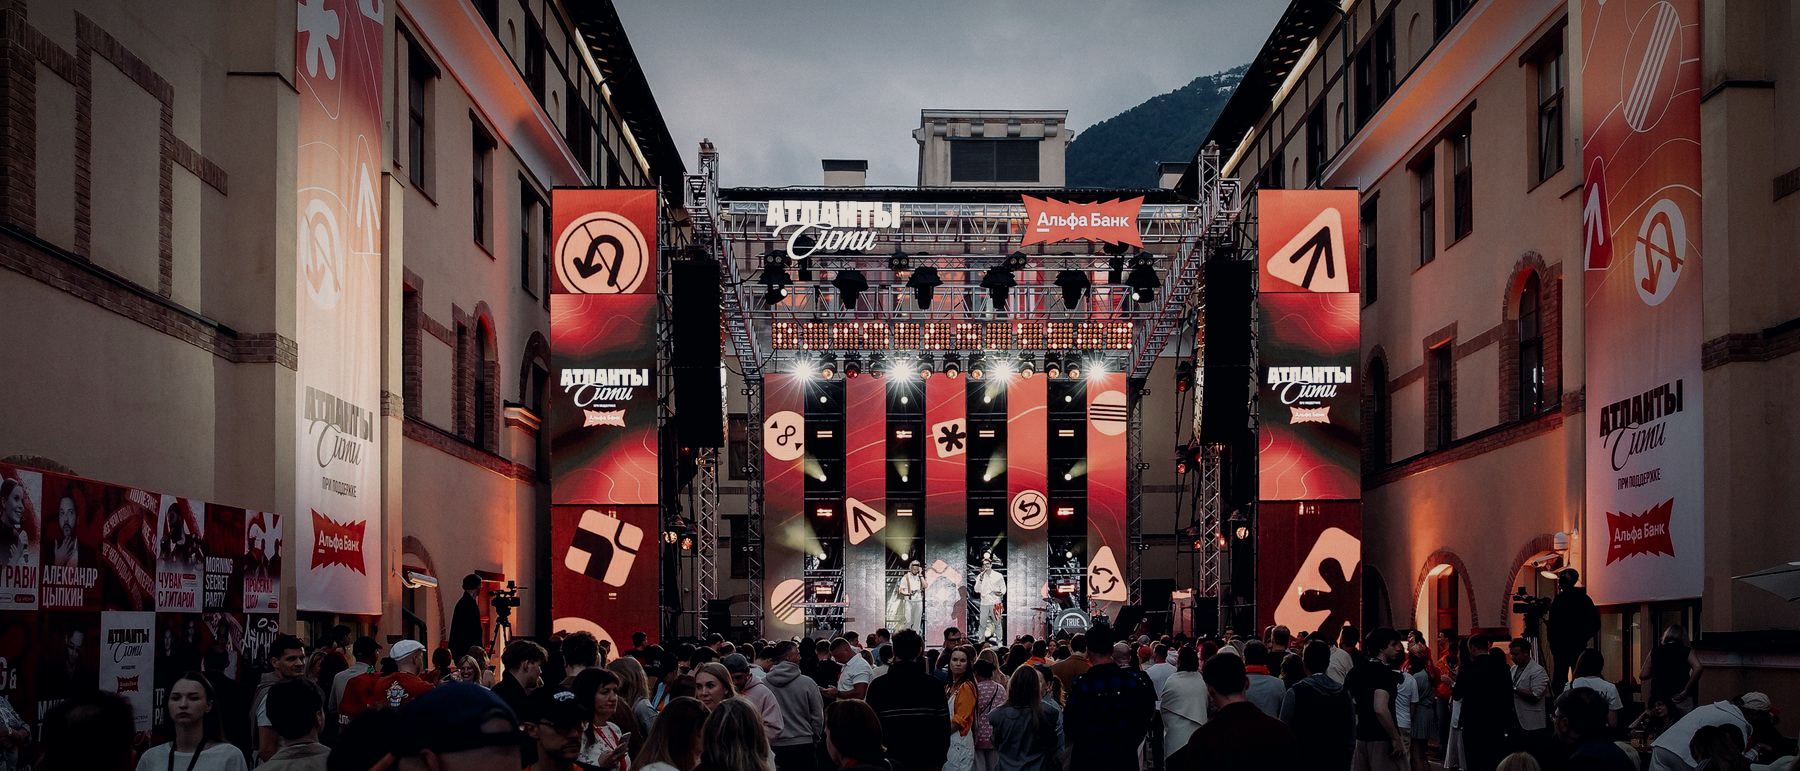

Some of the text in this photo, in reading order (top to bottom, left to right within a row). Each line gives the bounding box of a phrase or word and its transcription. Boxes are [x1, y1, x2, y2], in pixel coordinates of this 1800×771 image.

[766, 200, 901, 228] АТЛАНТЫ
[1037, 211, 1130, 231] Альфа Банк
[772, 222, 877, 260] Сити
[560, 368, 649, 386] АТЛАНТЫ
[1267, 366, 1352, 384] АТЛАНТЫ
[304, 385, 373, 443] АТЛАНТЫ
[1600, 379, 1684, 438] АТЛАНТЫ
[318, 530, 360, 553] Альфа Банк
[1614, 522, 1666, 545] Альфа Банк
[206, 556, 234, 574] MORNING
[0, 565, 37, 588] РАВИ
[42, 565, 99, 588] АЛЕКСАНДР
[158, 572, 183, 590] ЧУВАК
[205, 574, 229, 591] SECRET
[42, 587, 84, 608] ЦЫПКИН
[165, 589, 195, 608] ГИТАРОЙ
[205, 591, 226, 608] PARTY
[1066, 617, 1081, 627] TRUE
